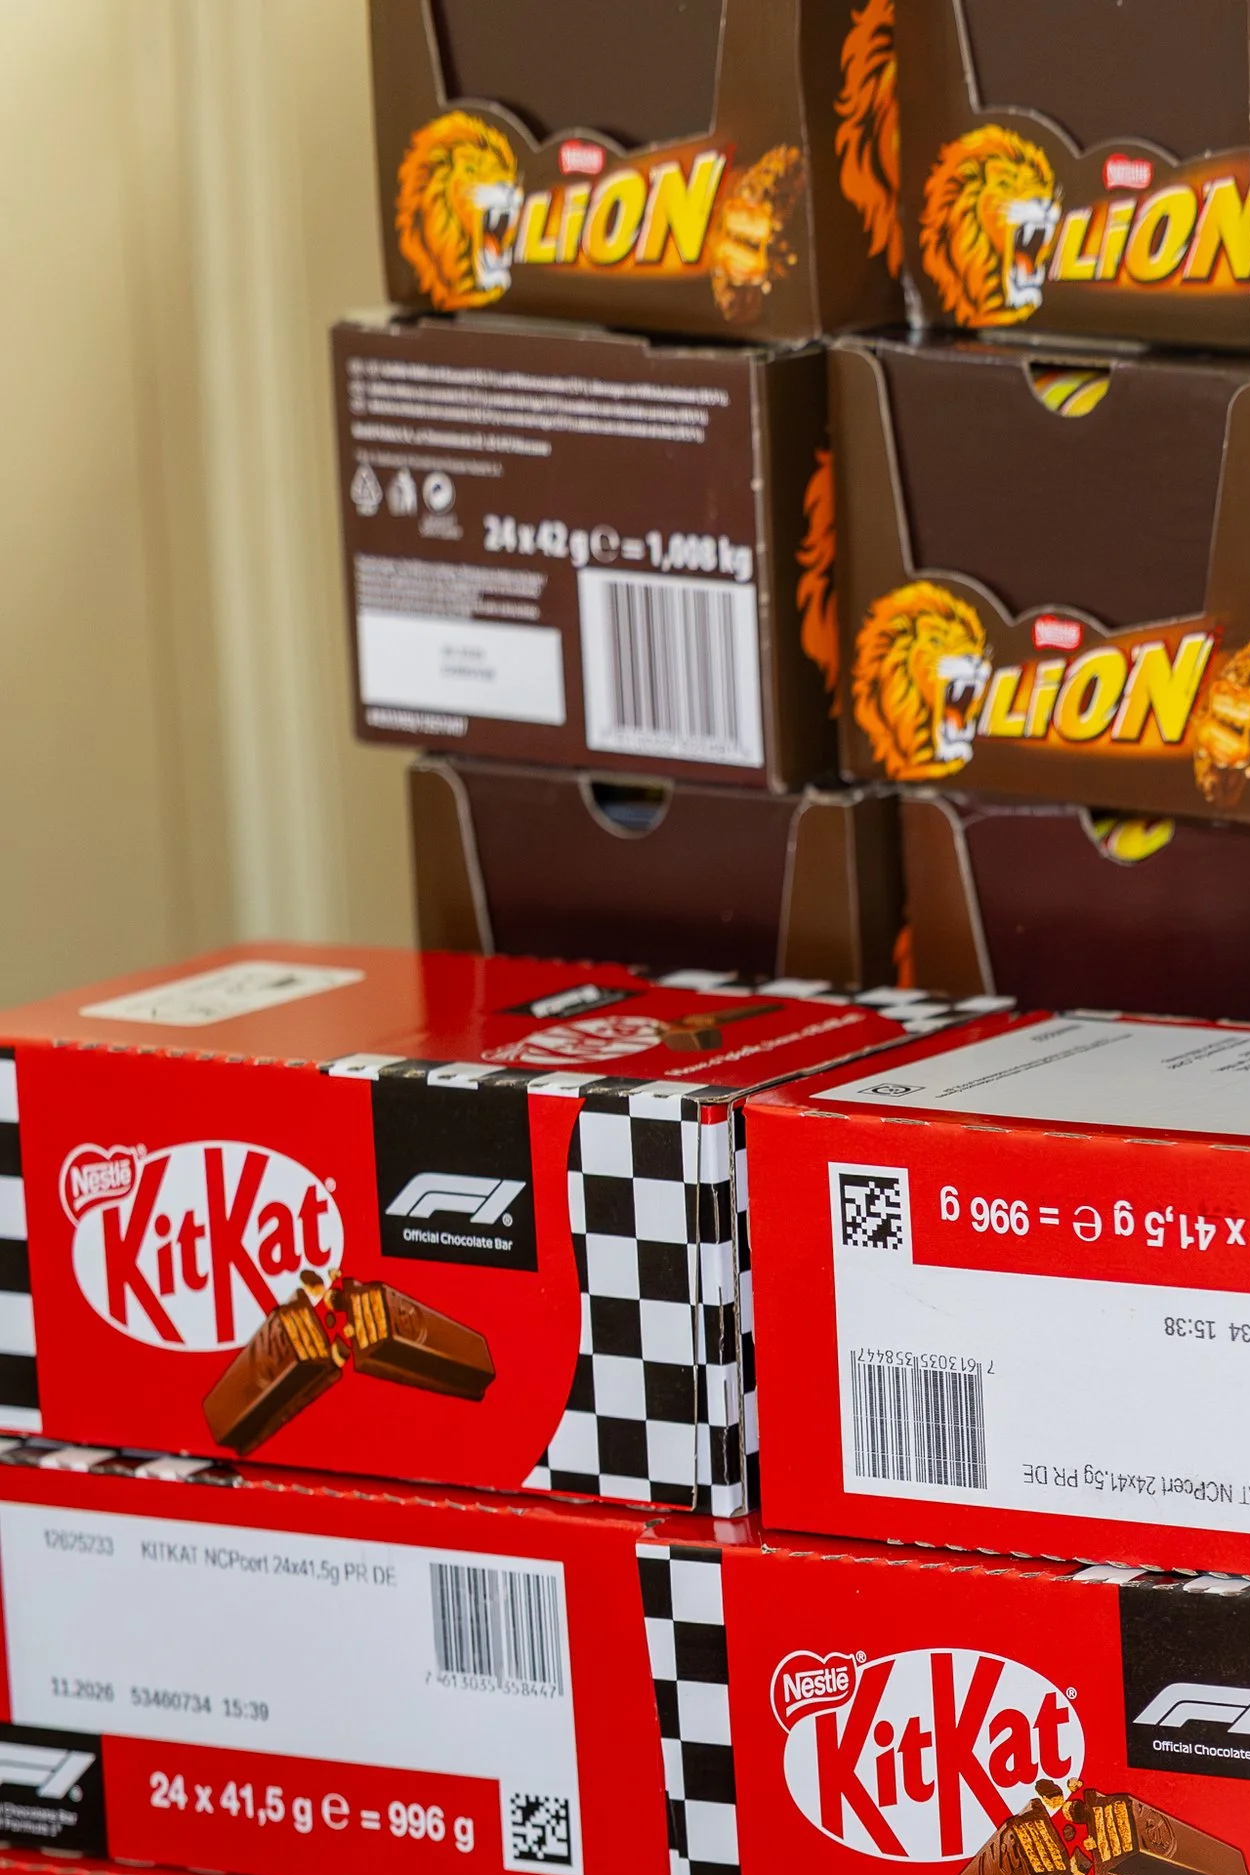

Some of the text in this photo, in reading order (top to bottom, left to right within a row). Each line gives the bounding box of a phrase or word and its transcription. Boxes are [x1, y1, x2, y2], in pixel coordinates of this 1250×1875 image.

[941, 1186, 960, 1221] g
[970, 1197, 1030, 1236] 996
[1039, 1208, 1060, 1226] =
[1113, 1200, 1135, 1236] g
[403, 1227, 513, 1252] Official Chocolate Bar
[1145, 1209, 1216, 1251] 41,5
[1226, 1229, 1246, 1245] x
[102, 1147, 334, 1344] KitKat
[1164, 1317, 1216, 1339] 15:38
[857, 1348, 996, 1374] 7 613035 358447
[1022, 1464, 1048, 1485] DE
[1053, 1467, 1079, 1488] PR
[1084, 1464, 1155, 1495] 24x41.5g
[1161, 1475, 1233, 1504] NCPcert
[815, 1652, 1070, 1857] KitKat
[1152, 1739, 1192, 1756] Official
[150, 1771, 474, 1853] 24 x 41,5 g = 996 g
